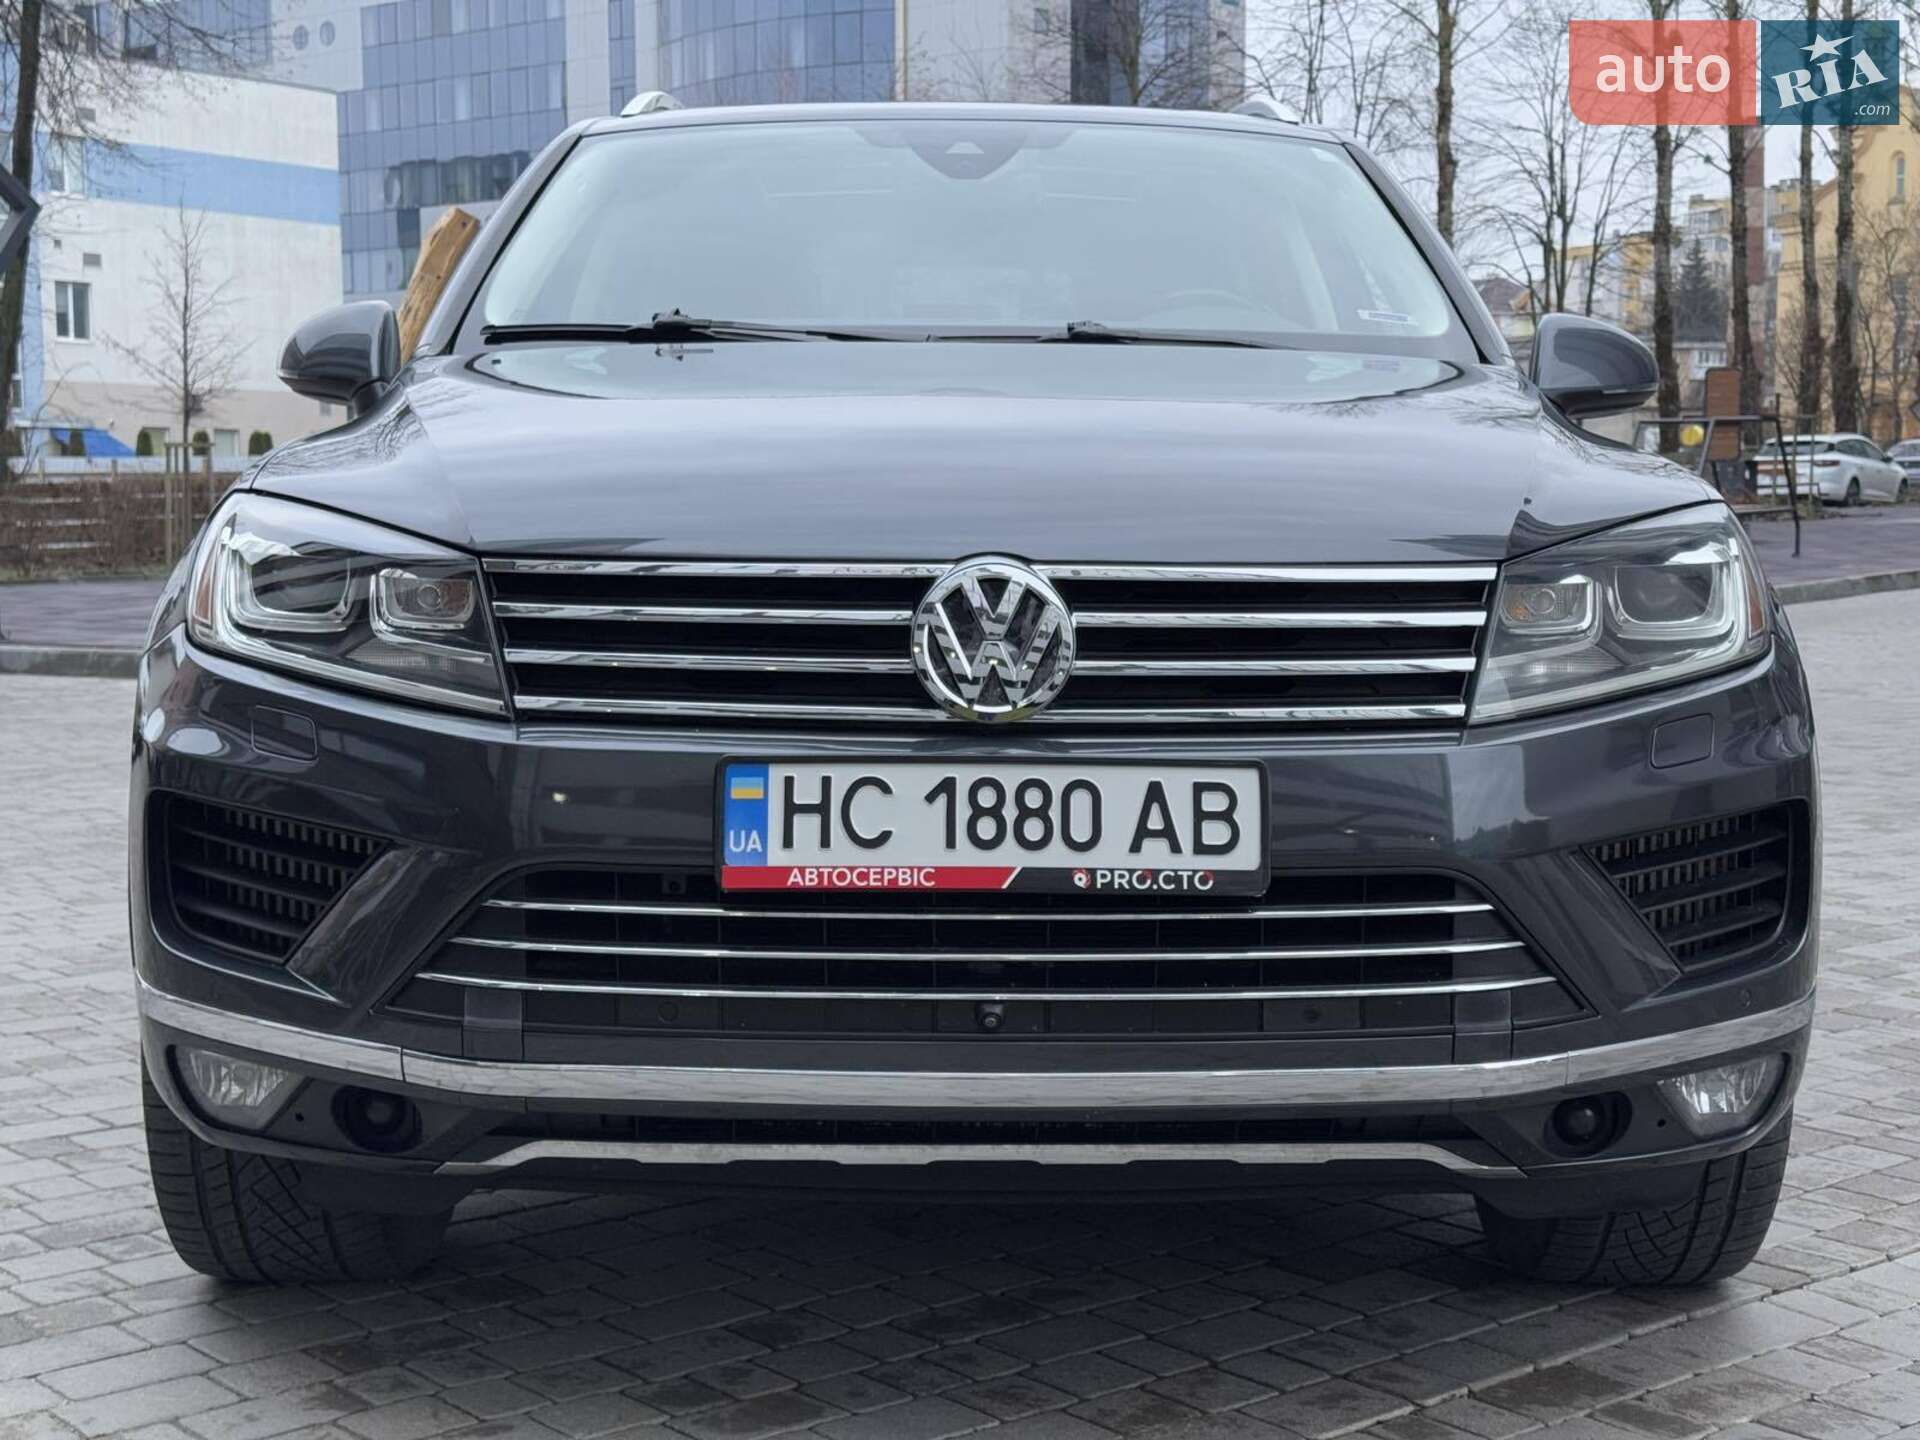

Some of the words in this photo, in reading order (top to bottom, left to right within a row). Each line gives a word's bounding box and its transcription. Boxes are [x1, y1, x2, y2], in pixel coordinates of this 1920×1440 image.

[782, 775, 894, 850] HC
[923, 776, 1103, 853] 1880
[1128, 780, 1241, 856] AB
[729, 829, 763, 853] UA
[787, 867, 936, 887] АВТОСЕРВІС
